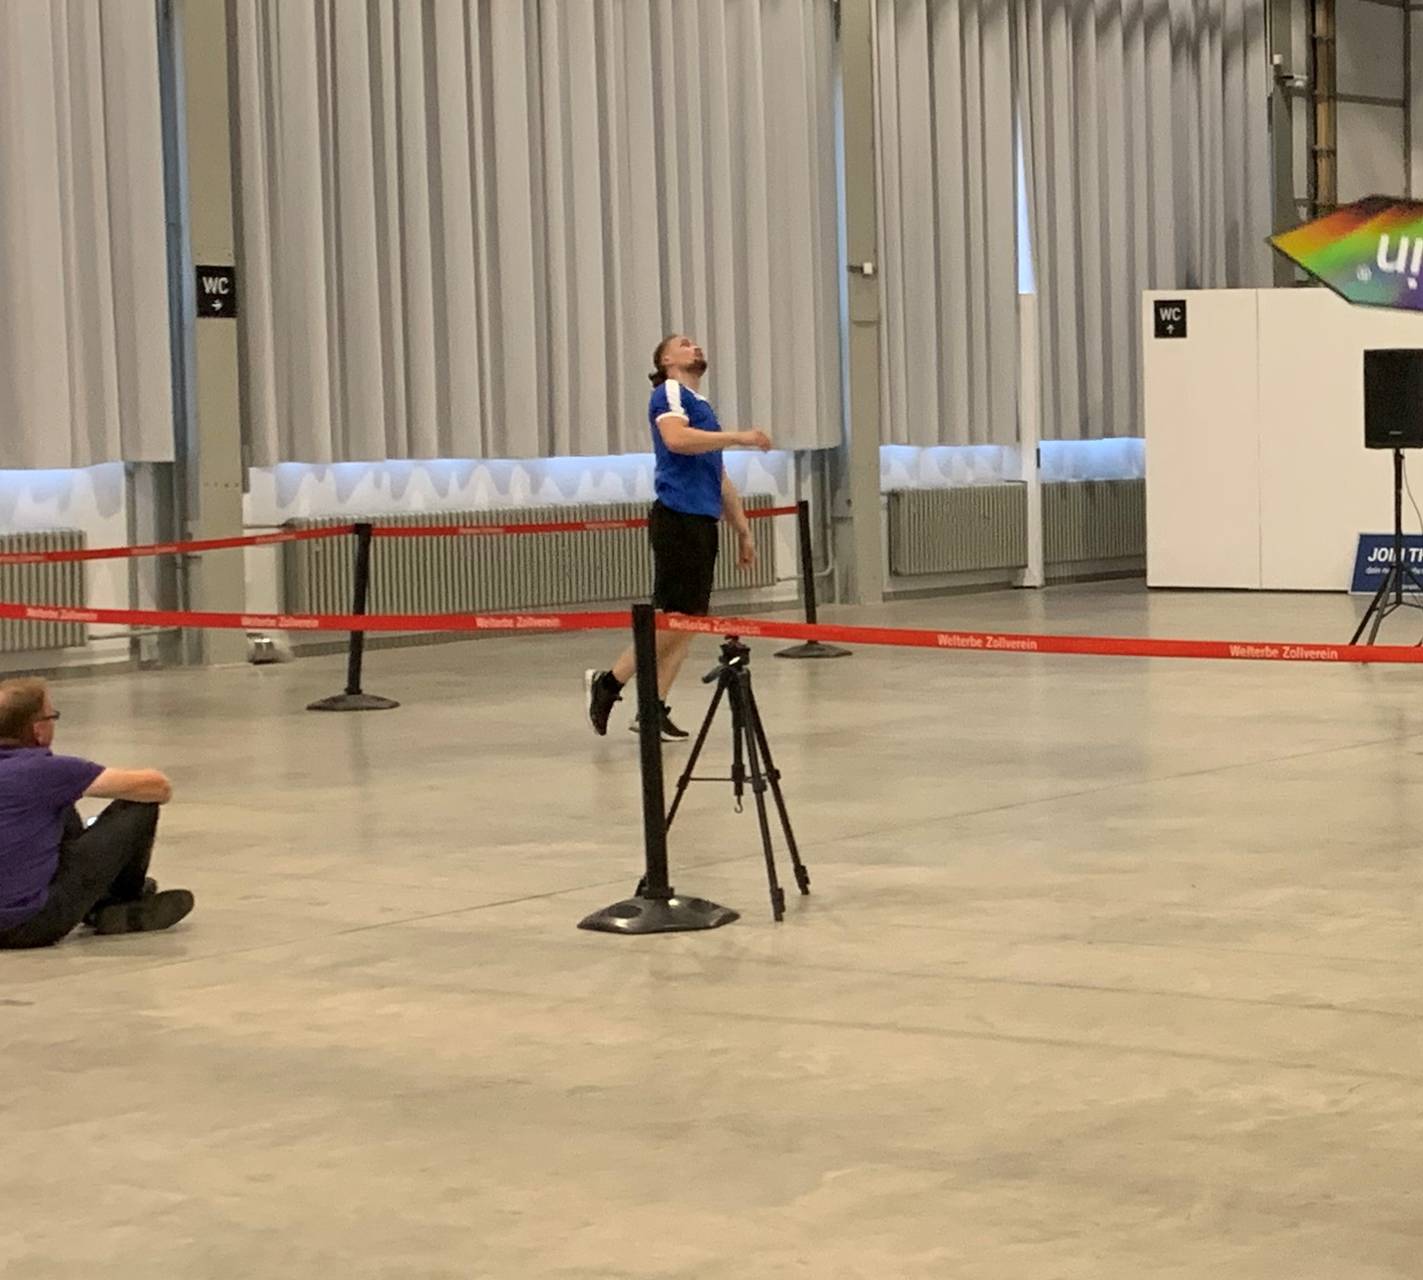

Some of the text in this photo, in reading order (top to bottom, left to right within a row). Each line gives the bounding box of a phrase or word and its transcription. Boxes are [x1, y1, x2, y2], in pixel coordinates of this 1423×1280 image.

[202, 276, 229, 294] WC
[1159, 307, 1182, 321] WC
[938, 634, 1037, 650] Welterbe Zollverein
[1229, 645, 1338, 660] Welterbe Zollverein
